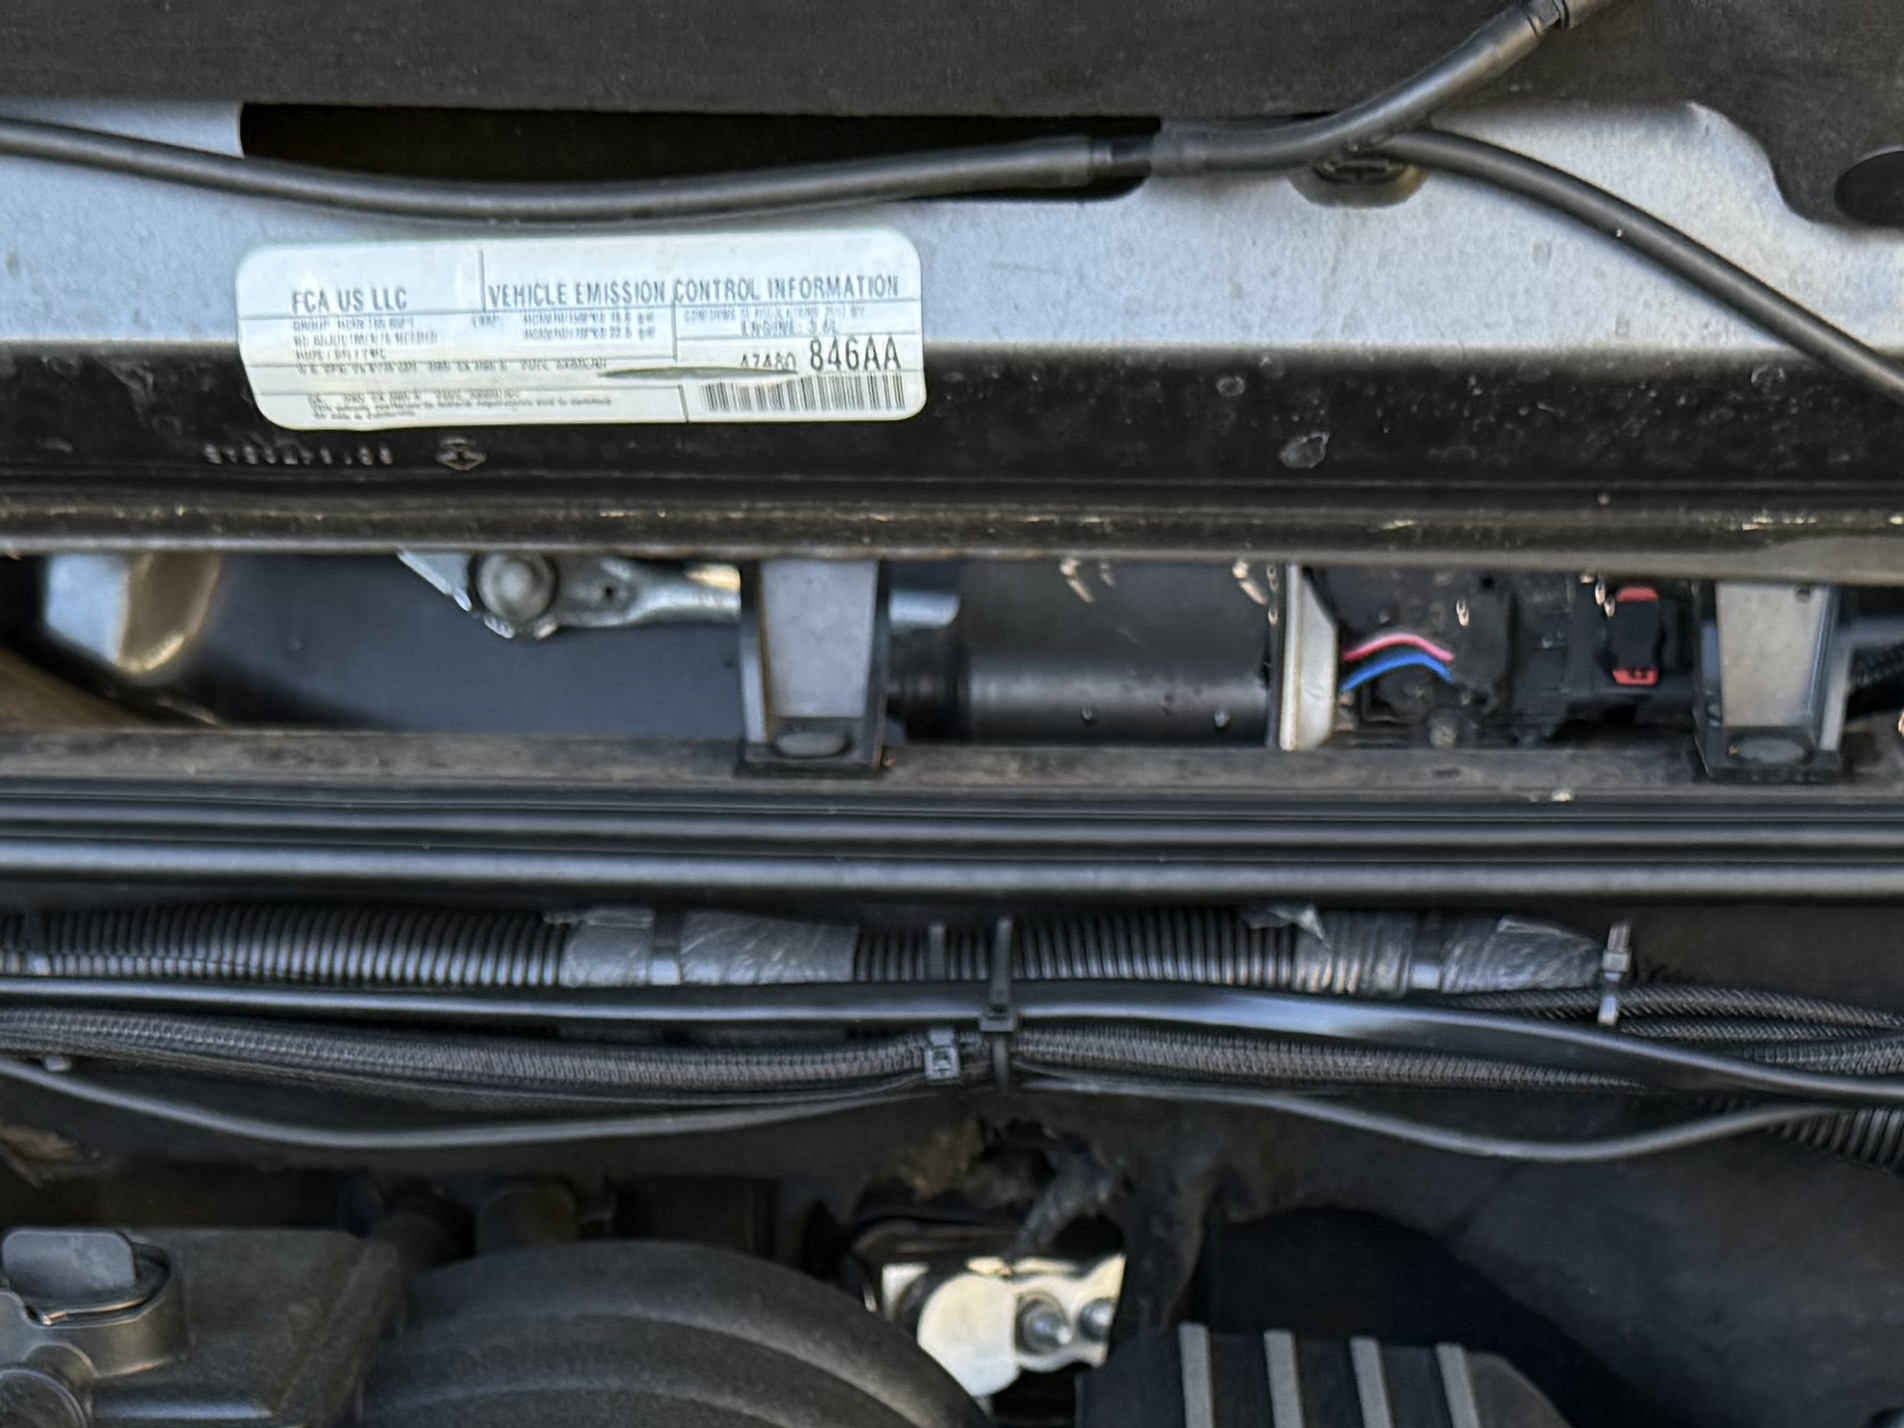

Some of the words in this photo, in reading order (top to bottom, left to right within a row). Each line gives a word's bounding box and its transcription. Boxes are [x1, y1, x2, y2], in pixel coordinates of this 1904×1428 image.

[292, 289, 330, 314] FCA
[338, 288, 363, 312] US
[371, 286, 407, 311] LLC
[488, 281, 567, 307] VEHICLE
[575, 279, 665, 305] EMISSION
[674, 277, 759, 303] CONTROL
[767, 274, 899, 300] INFORMATION
[810, 335, 902, 372] 846AA
